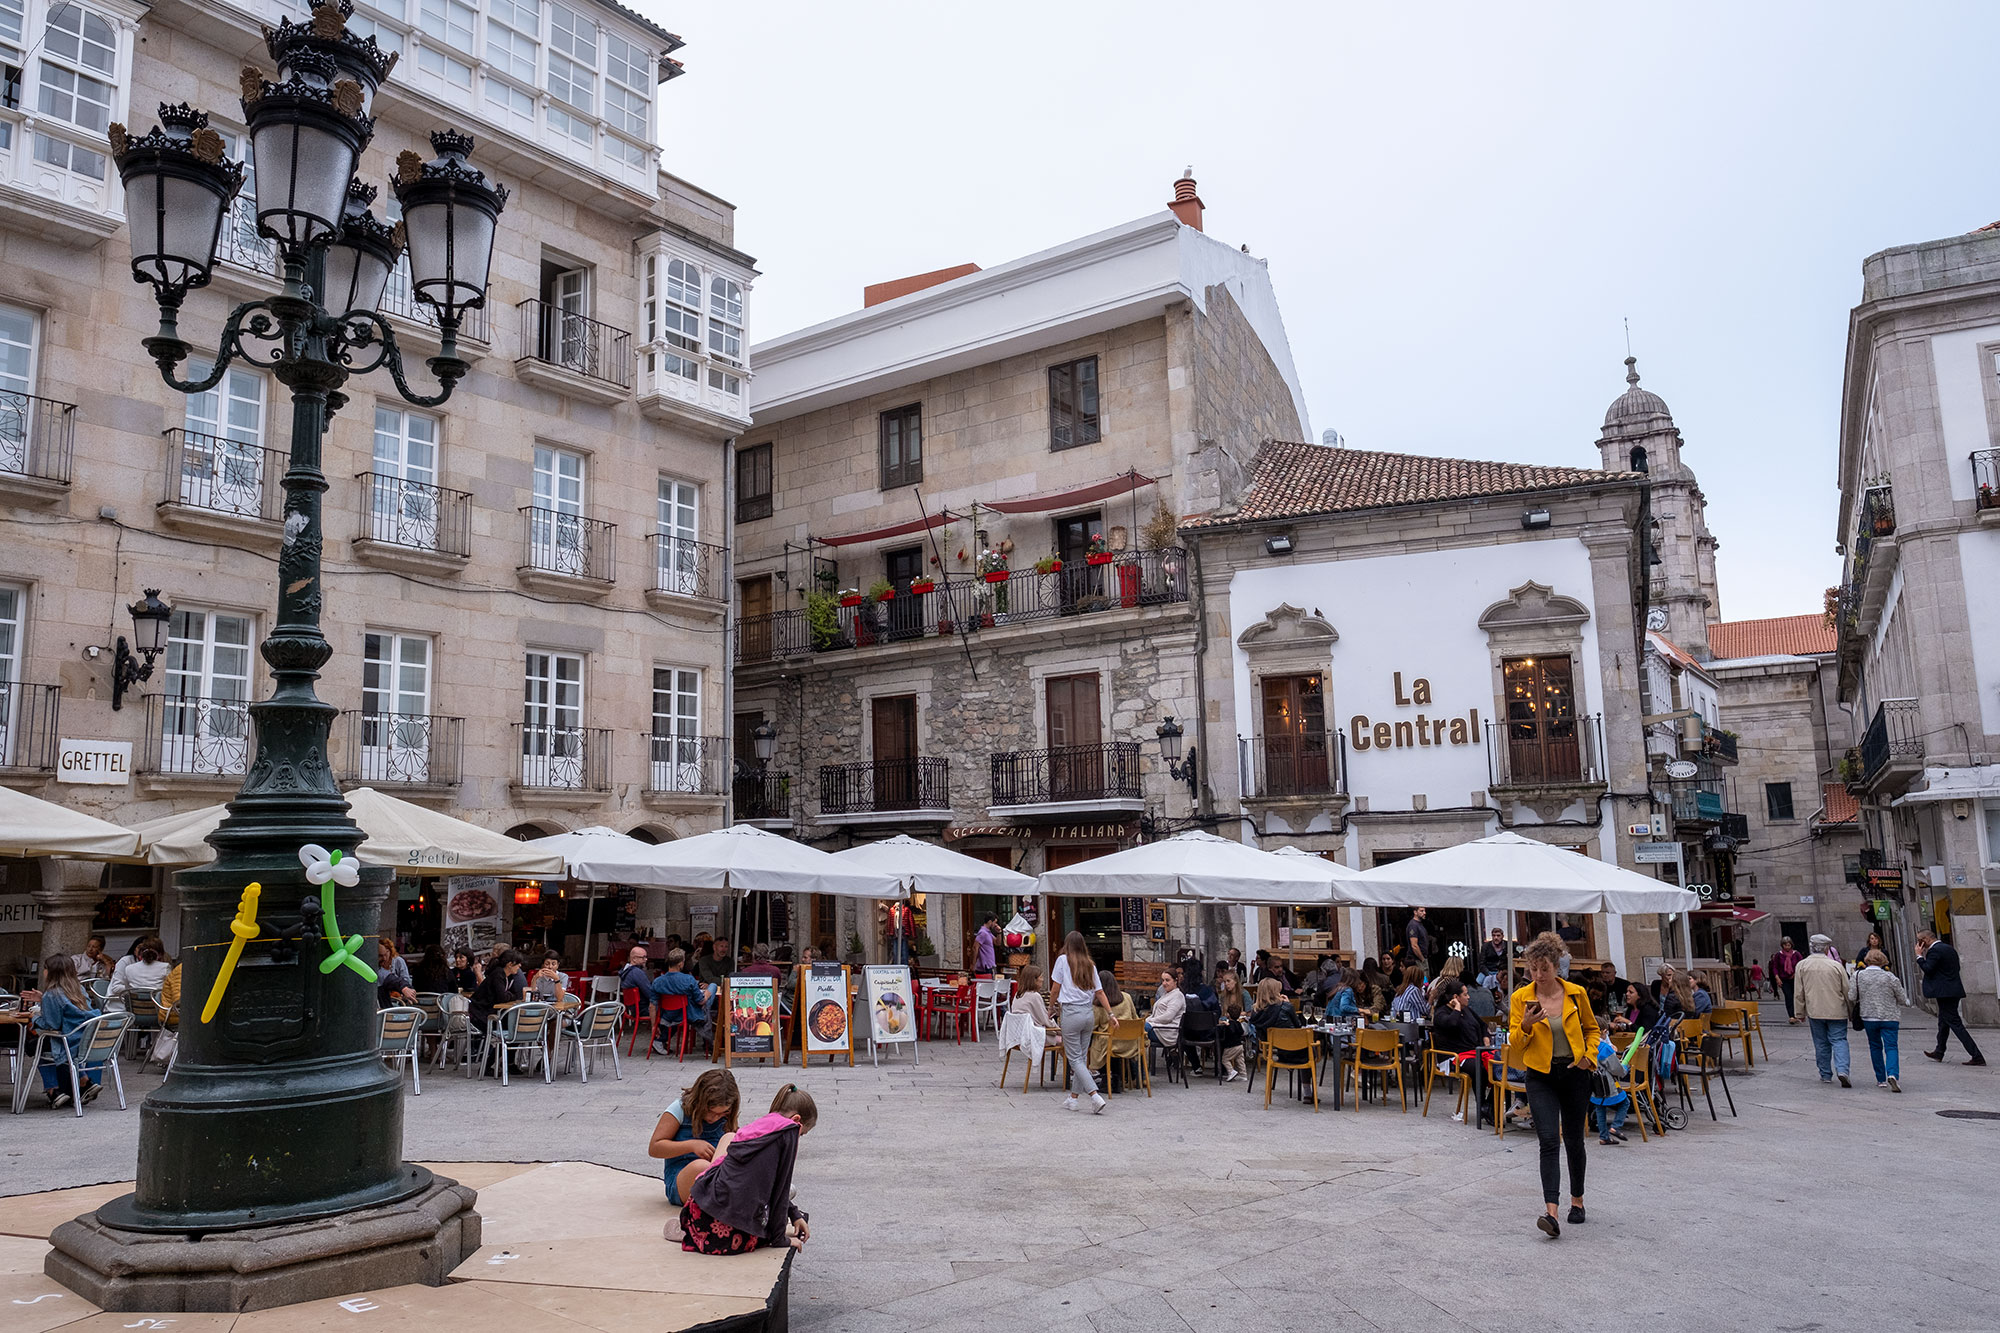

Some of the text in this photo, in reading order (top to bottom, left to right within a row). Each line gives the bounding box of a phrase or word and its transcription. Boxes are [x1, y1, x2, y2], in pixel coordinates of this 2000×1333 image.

[1393, 671, 1432, 706] La
[1350, 708, 1481, 751] Central
[61, 750, 127, 773] GRETTEL
[1052, 824, 1125, 838] ITALIANA
[407, 849, 460, 866] grettel
[337, 1297, 380, 1314] E
[123, 1318, 178, 1330] SE
